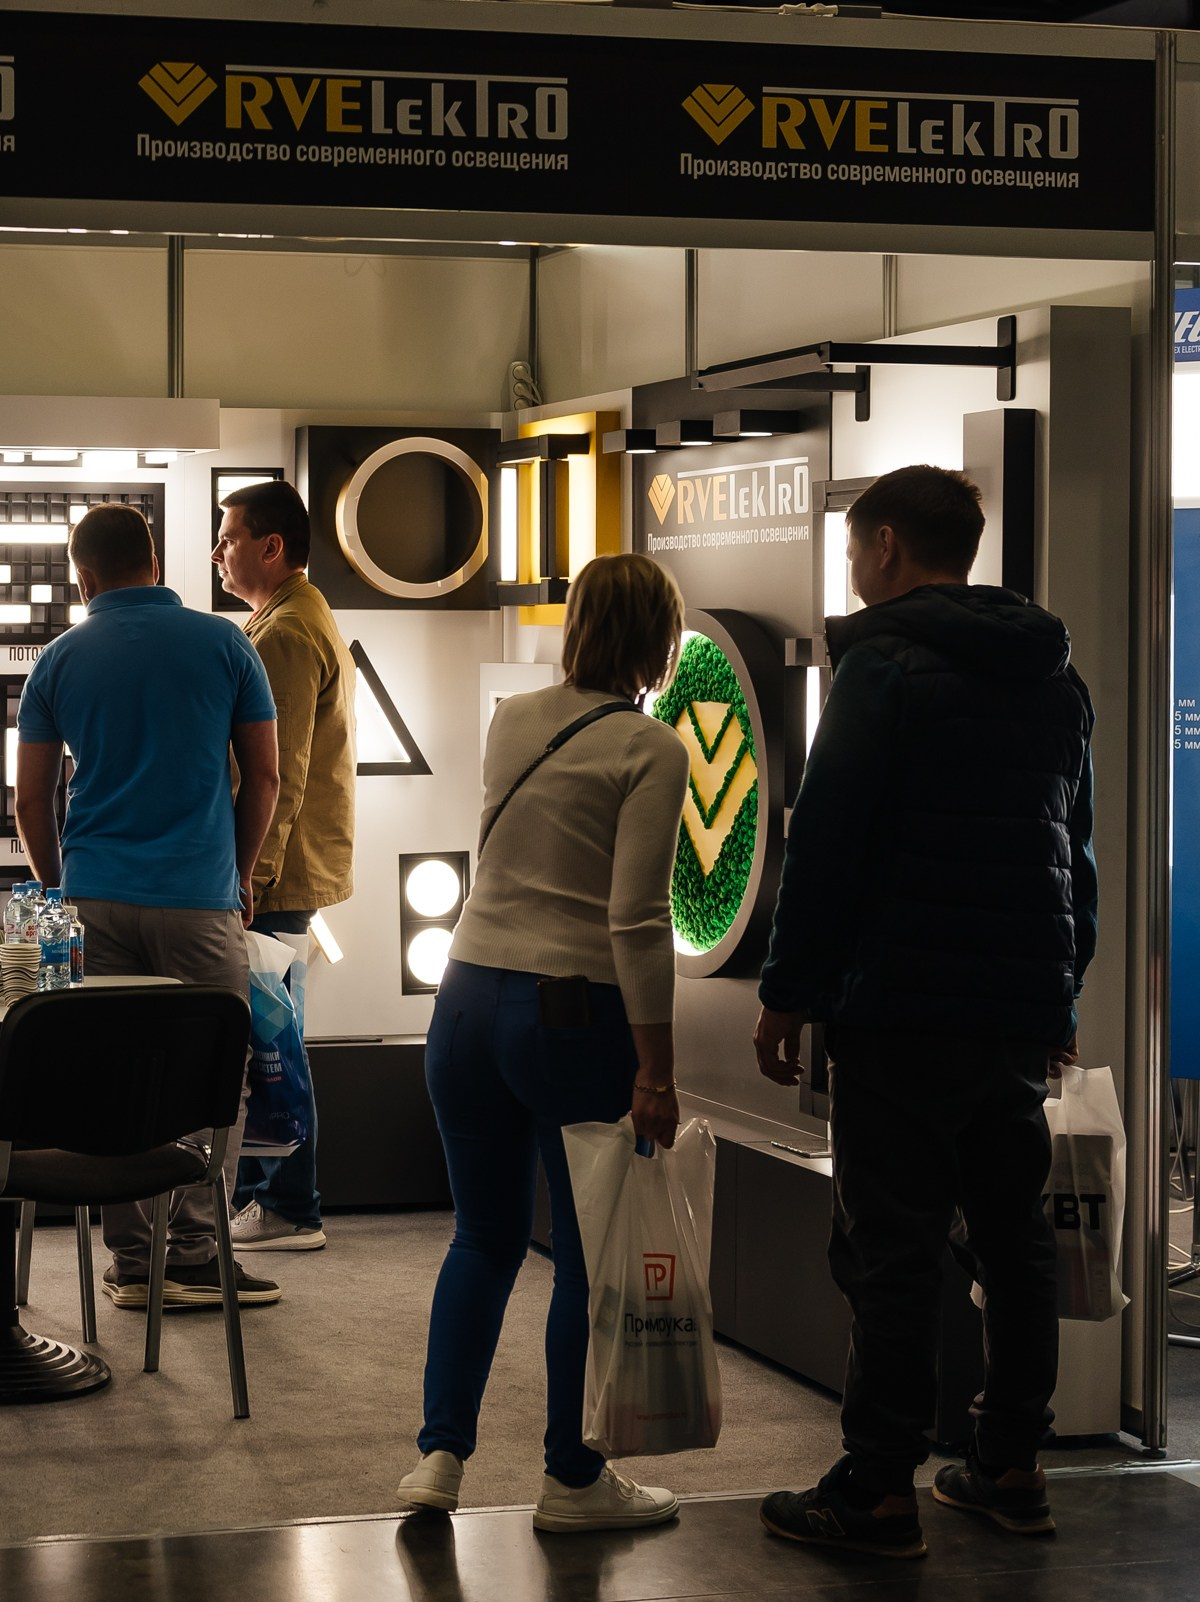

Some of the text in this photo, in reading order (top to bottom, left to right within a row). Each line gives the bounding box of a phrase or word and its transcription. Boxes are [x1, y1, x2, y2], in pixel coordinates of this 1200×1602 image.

[137, 133, 569, 172] Производство современного освещения
[680, 152, 1080, 190] Производство современного освещения
[647, 525, 809, 555] Производство современного освещения
[9, 646, 44, 661] ПОТО
[1174, 710, 1182, 721] 5
[1174, 724, 1182, 735] 5
[1174, 738, 1182, 749] 5
[1042, 1193, 1106, 1230] ВТ
